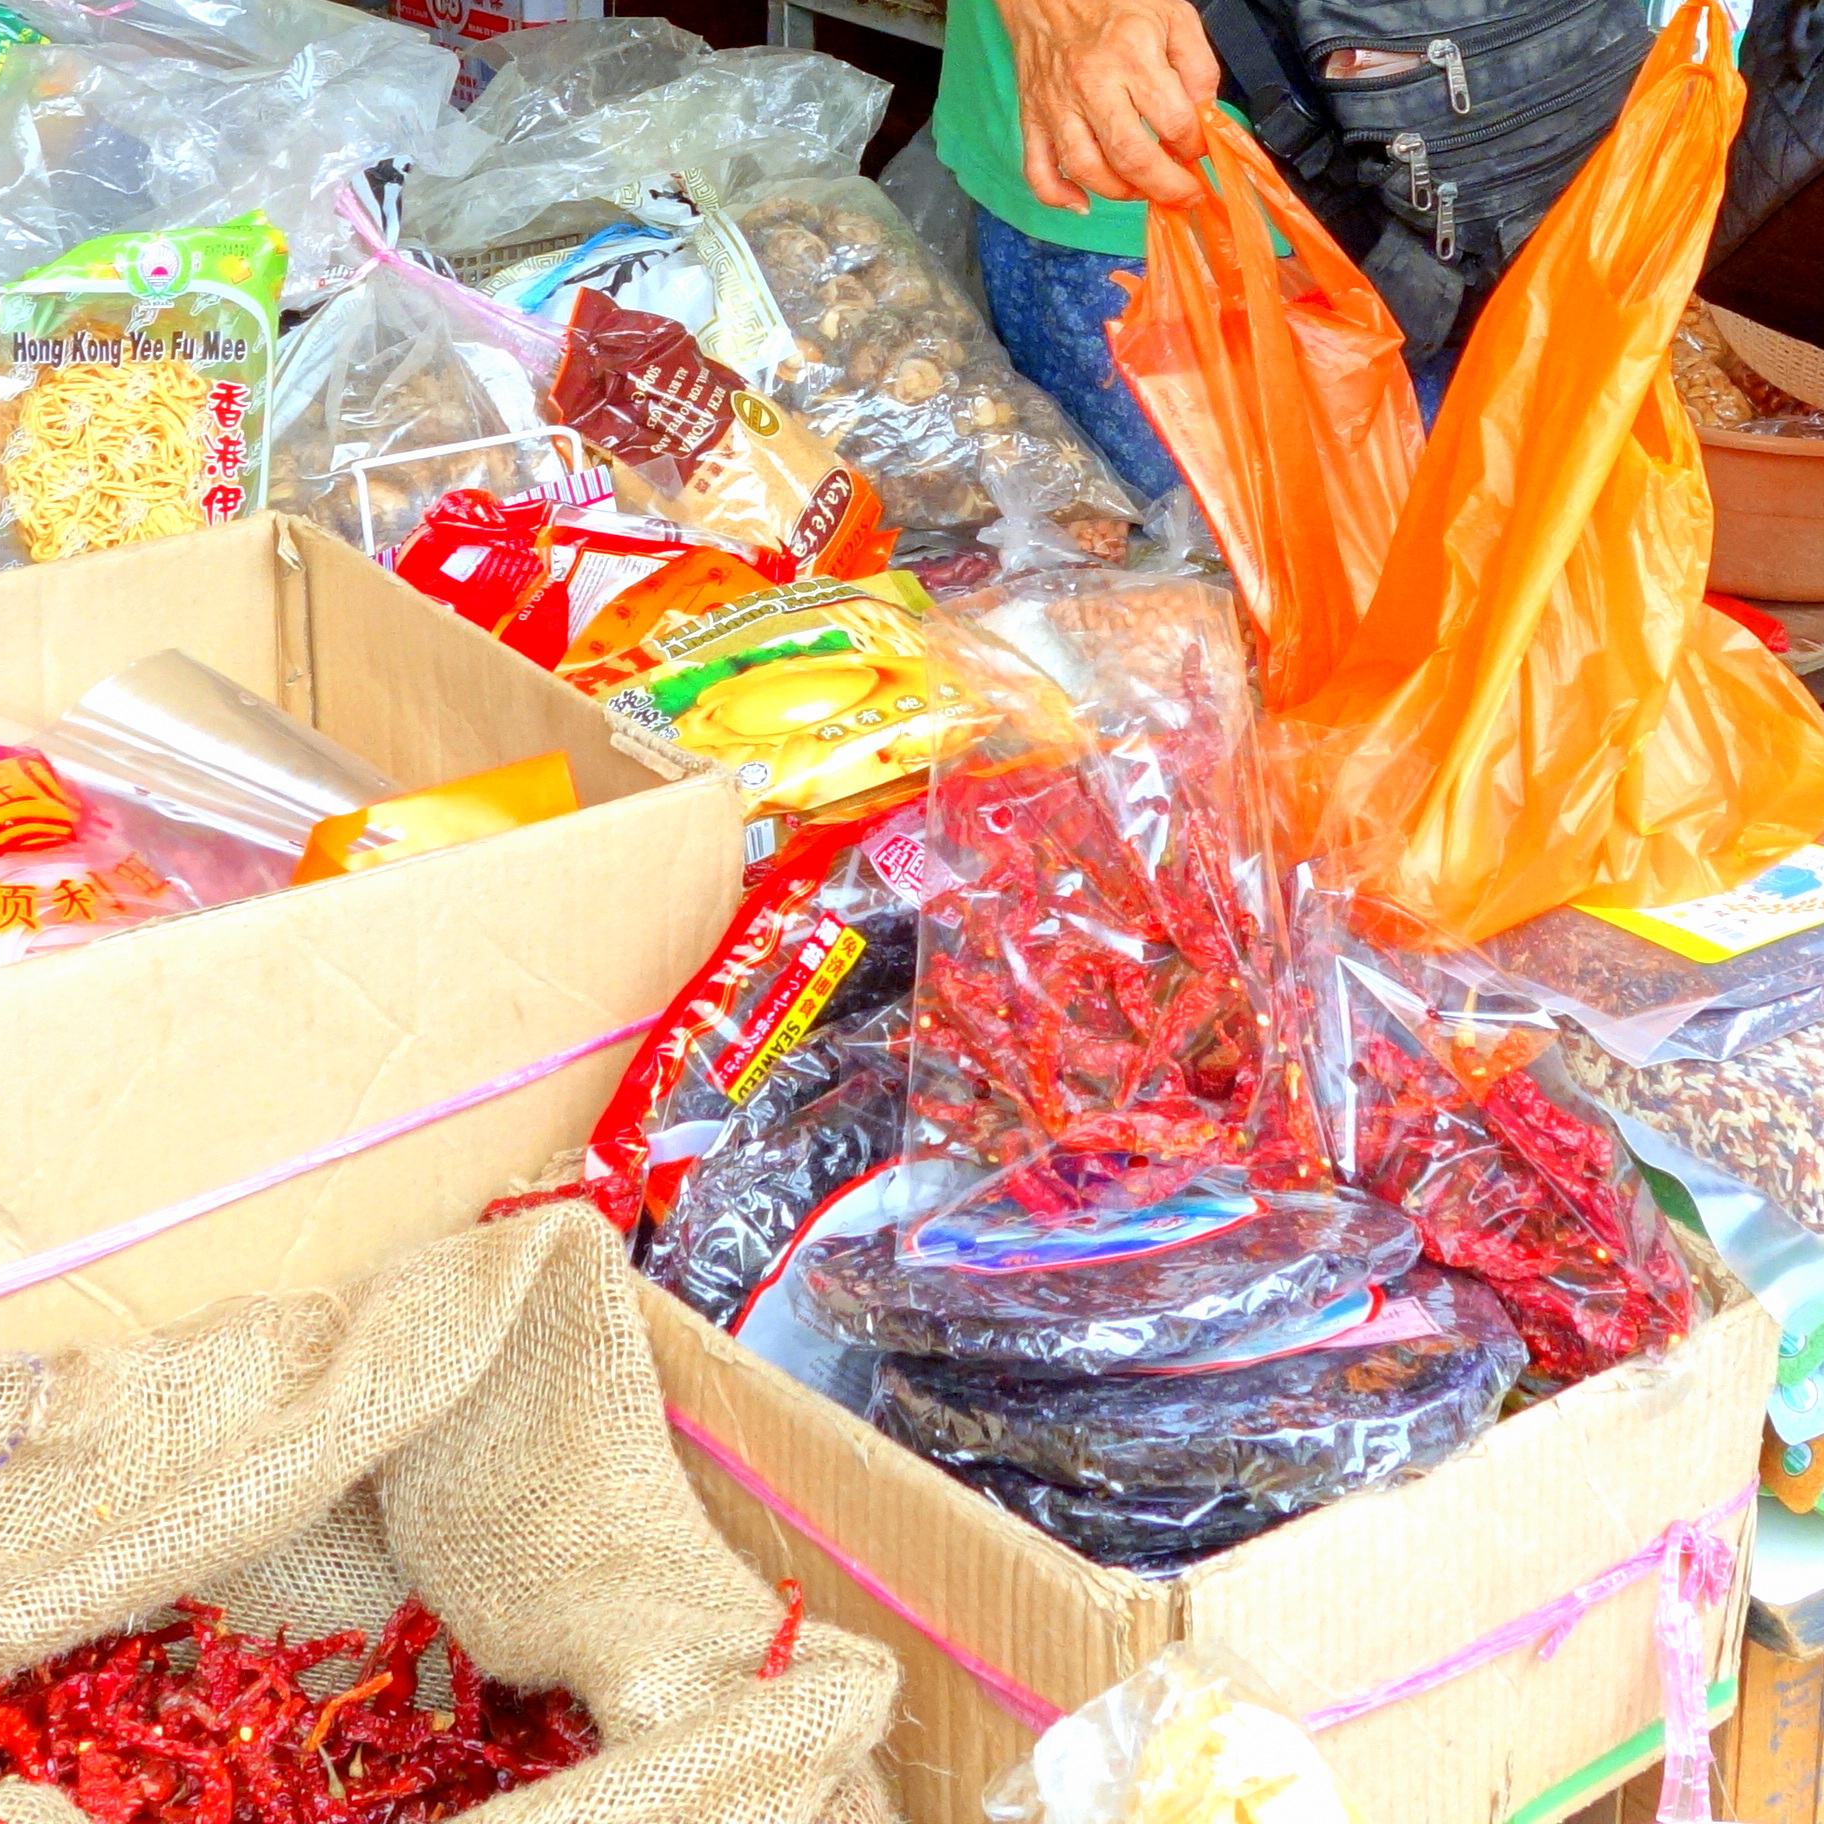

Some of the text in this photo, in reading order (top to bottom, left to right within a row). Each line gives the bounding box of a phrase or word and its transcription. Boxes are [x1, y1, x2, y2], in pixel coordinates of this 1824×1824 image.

[13, 329, 247, 368] Hong Kong Yee Fu Mee
[679, 385, 725, 453] RICH AROMA
